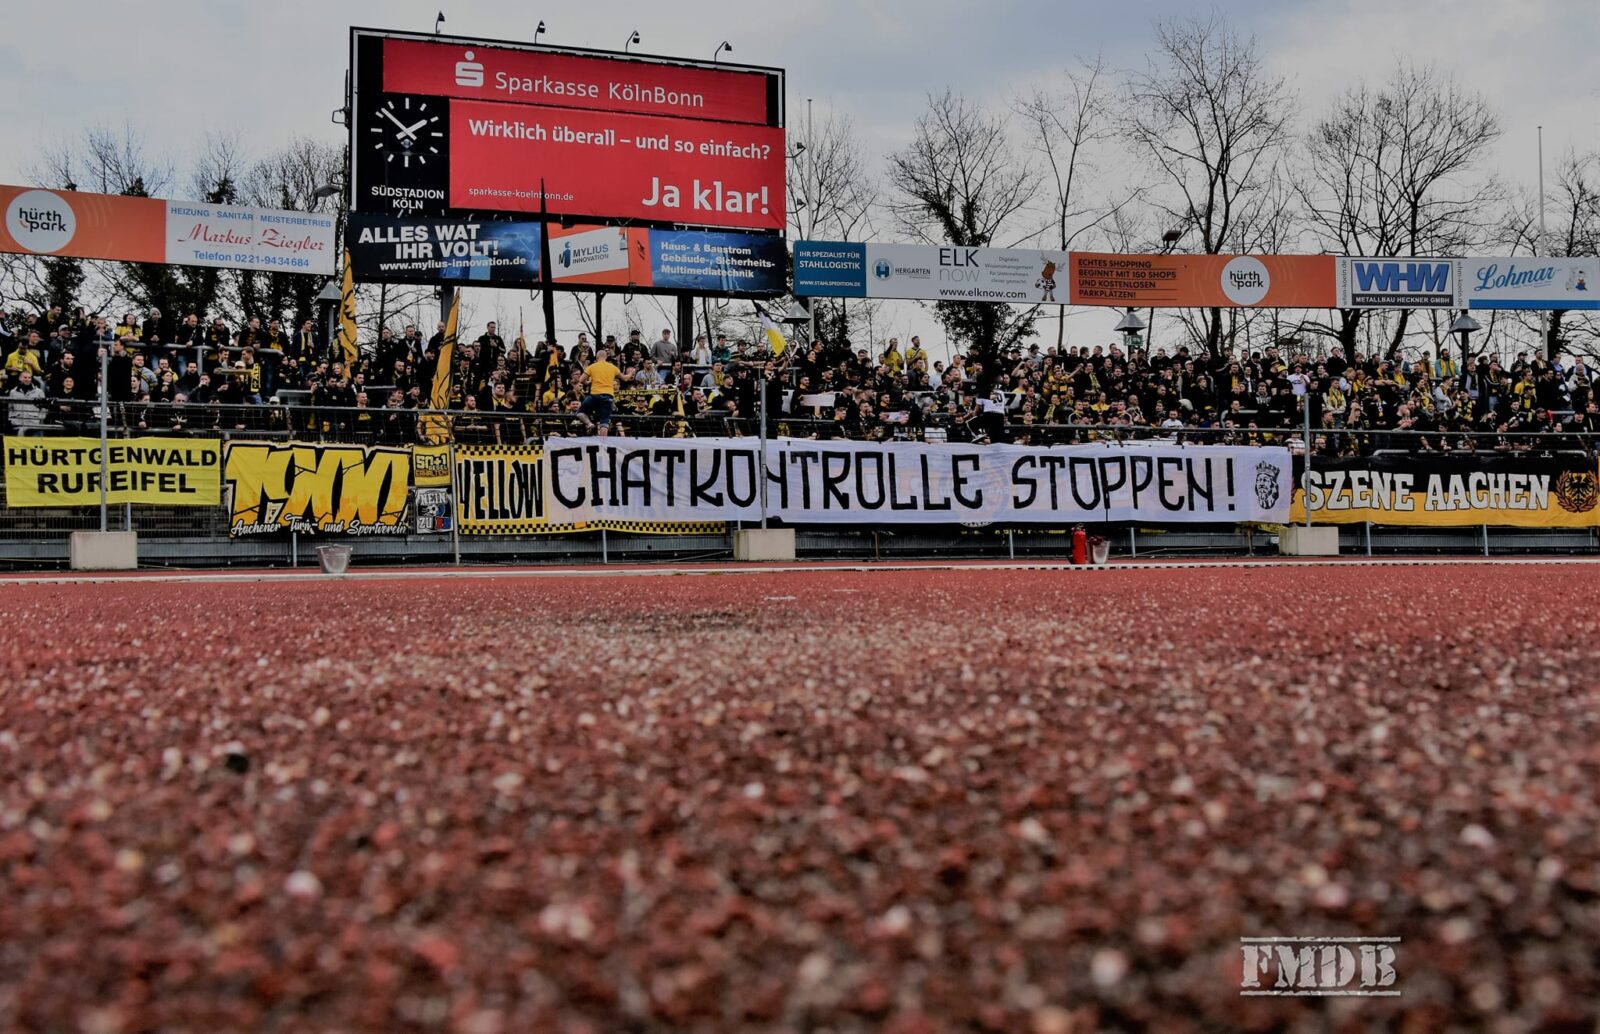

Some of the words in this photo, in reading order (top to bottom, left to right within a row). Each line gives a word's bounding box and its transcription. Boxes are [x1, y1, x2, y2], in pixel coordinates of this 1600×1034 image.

[495, 72, 599, 97] Sparkasse
[609, 82, 704, 107] KölnBonn
[469, 119, 547, 141] Wirklich
[552, 126, 615, 146] überall
[635, 134, 669, 151] und
[674, 139, 695, 153] so
[699, 140, 770, 160] einfach?
[371, 185, 444, 199] SÜDSTADION
[641, 176, 680, 209] Ja
[693, 179, 769, 215] klar!
[392, 197, 424, 209] KÖLN
[19, 207, 62, 222] hürth
[170, 207, 210, 217] HEIZUNG
[216, 210, 254, 221] SANITÄR
[260, 215, 332, 228] MEISTERBETRIEB
[29, 220, 67, 233] park
[358, 226, 429, 243] ALLES
[435, 224, 480, 242] WAT
[177, 223, 252, 246] Markus
[258, 228, 325, 254] Ziegler
[395, 243, 433, 260] IHR
[439, 240, 499, 258] VOLT!
[573, 244, 609, 257] MYLIUS
[661, 242, 690, 251] Haus-
[693, 243, 701, 252] &
[704, 244, 752, 255] Baustrom
[847, 250, 860, 259] FÜR
[193, 250, 232, 262] Telefon
[235, 254, 310, 268] 0221-9434684
[380, 256, 527, 271] www.mylius-innovation.de
[573, 254, 609, 264] INNOVATION
[661, 253, 713, 265] Gebäude-,
[715, 256, 776, 268] Sicherheits-
[939, 248, 980, 267] ELK
[1078, 259, 1107, 267] ECHTES
[1109, 260, 1152, 269] SHOPPING
[661, 265, 754, 278] Multimediatechnik
[799, 261, 861, 270] STAHLLOGISTIK
[895, 267, 931, 275] HERGARTEN
[939, 268, 980, 282] now
[1078, 269, 1113, 277] BEGINNT
[1116, 270, 1130, 278] MIT
[1148, 271, 1176, 279] SHOPS
[1229, 270, 1260, 281] hürth
[1354, 263, 1450, 292] WHM
[1474, 264, 1560, 291] Lohmar
[1078, 279, 1096, 287] UND
[1098, 280, 1156, 289] KOSTENLOSEN
[1236, 279, 1264, 290] park
[939, 288, 1027, 299] www.elknow.com
[1078, 289, 1136, 298] PARKPLÄTZEN!
[8, 445, 217, 467] HÜRTGENWALD
[416, 453, 447, 470] 50+1
[37, 470, 196, 494] RUREIFEL
[550, 445, 983, 509] CHATKONTROLLE
[1011, 455, 1235, 511] STOPPEN!
[456, 459, 543, 519] YELLOW
[1301, 470, 1414, 511] SZENE
[1424, 472, 1550, 511] AACHEN
[420, 492, 446, 505] NEIN
[231, 518, 281, 536] Aachener
[324, 522, 344, 533] und
[347, 520, 407, 535] Sportverein
[419, 517, 432, 529] ZU
